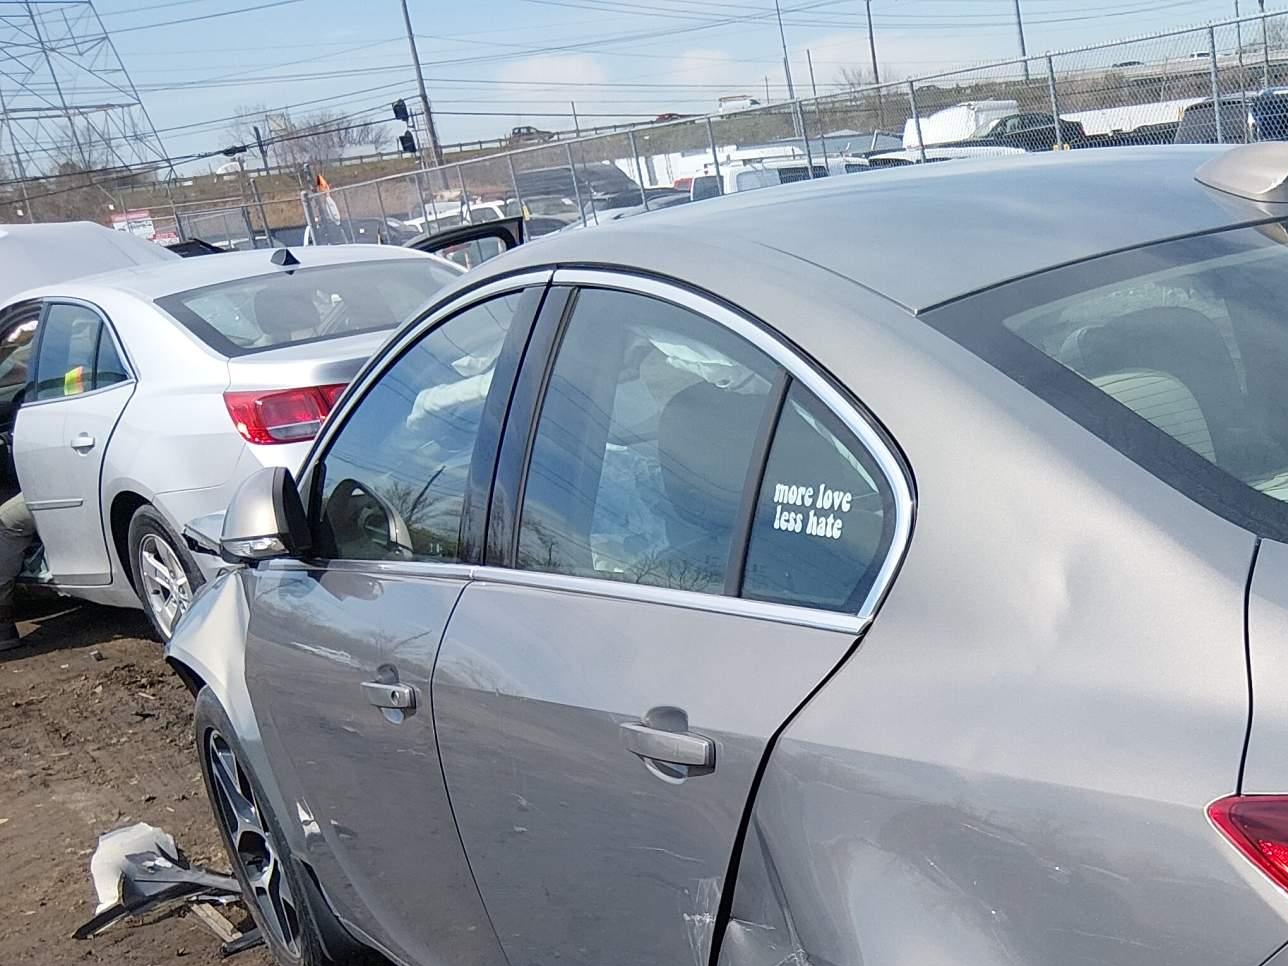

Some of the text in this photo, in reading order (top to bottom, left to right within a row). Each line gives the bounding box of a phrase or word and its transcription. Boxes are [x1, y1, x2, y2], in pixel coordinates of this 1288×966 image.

[774, 483, 852, 512] more love
[774, 504, 843, 539] less hate
